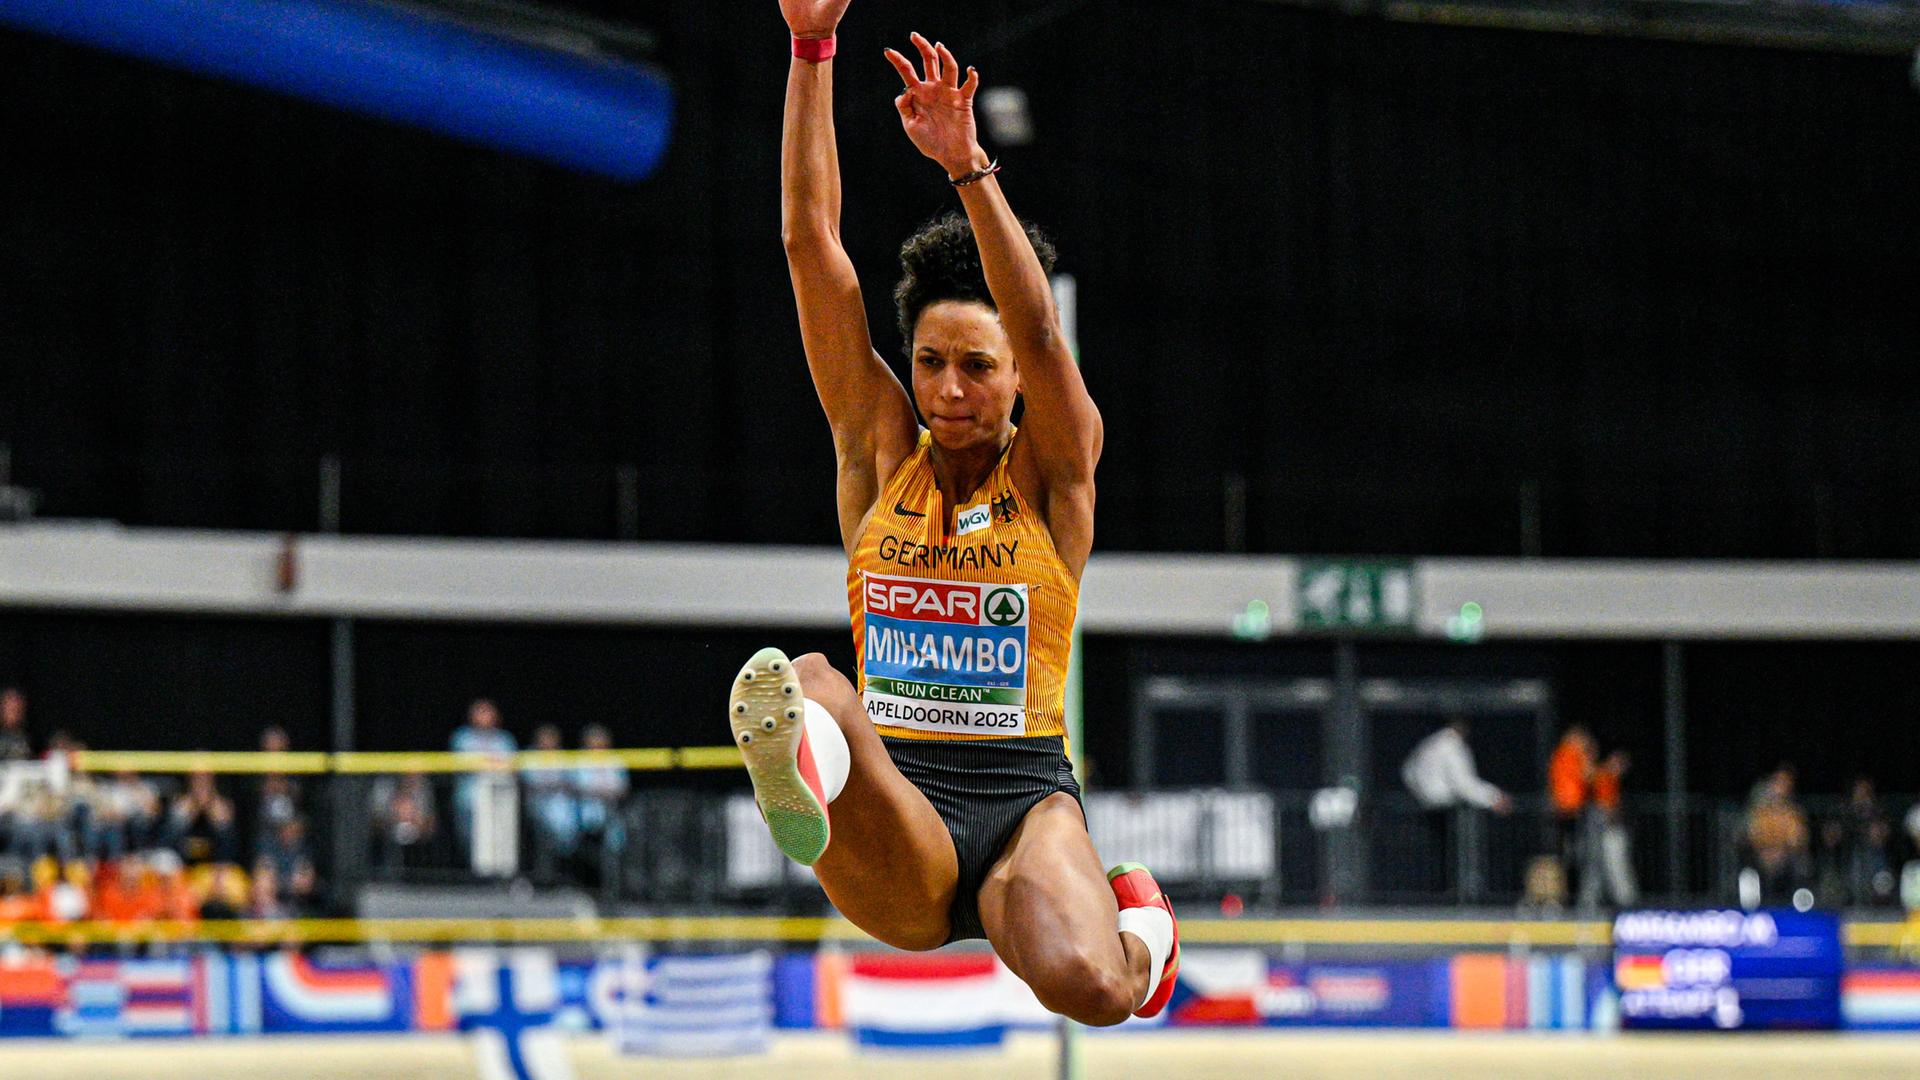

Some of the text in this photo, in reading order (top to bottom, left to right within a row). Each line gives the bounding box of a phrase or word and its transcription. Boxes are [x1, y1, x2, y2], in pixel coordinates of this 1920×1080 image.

[959, 511, 990, 530] WGV
[879, 535, 1018, 570] GERMANY
[867, 582, 976, 619] SPAR
[868, 625, 1021, 674] MIHAMBO
[897, 681, 928, 699] RUN
[867, 700, 1019, 728] APELDOORN 2025
